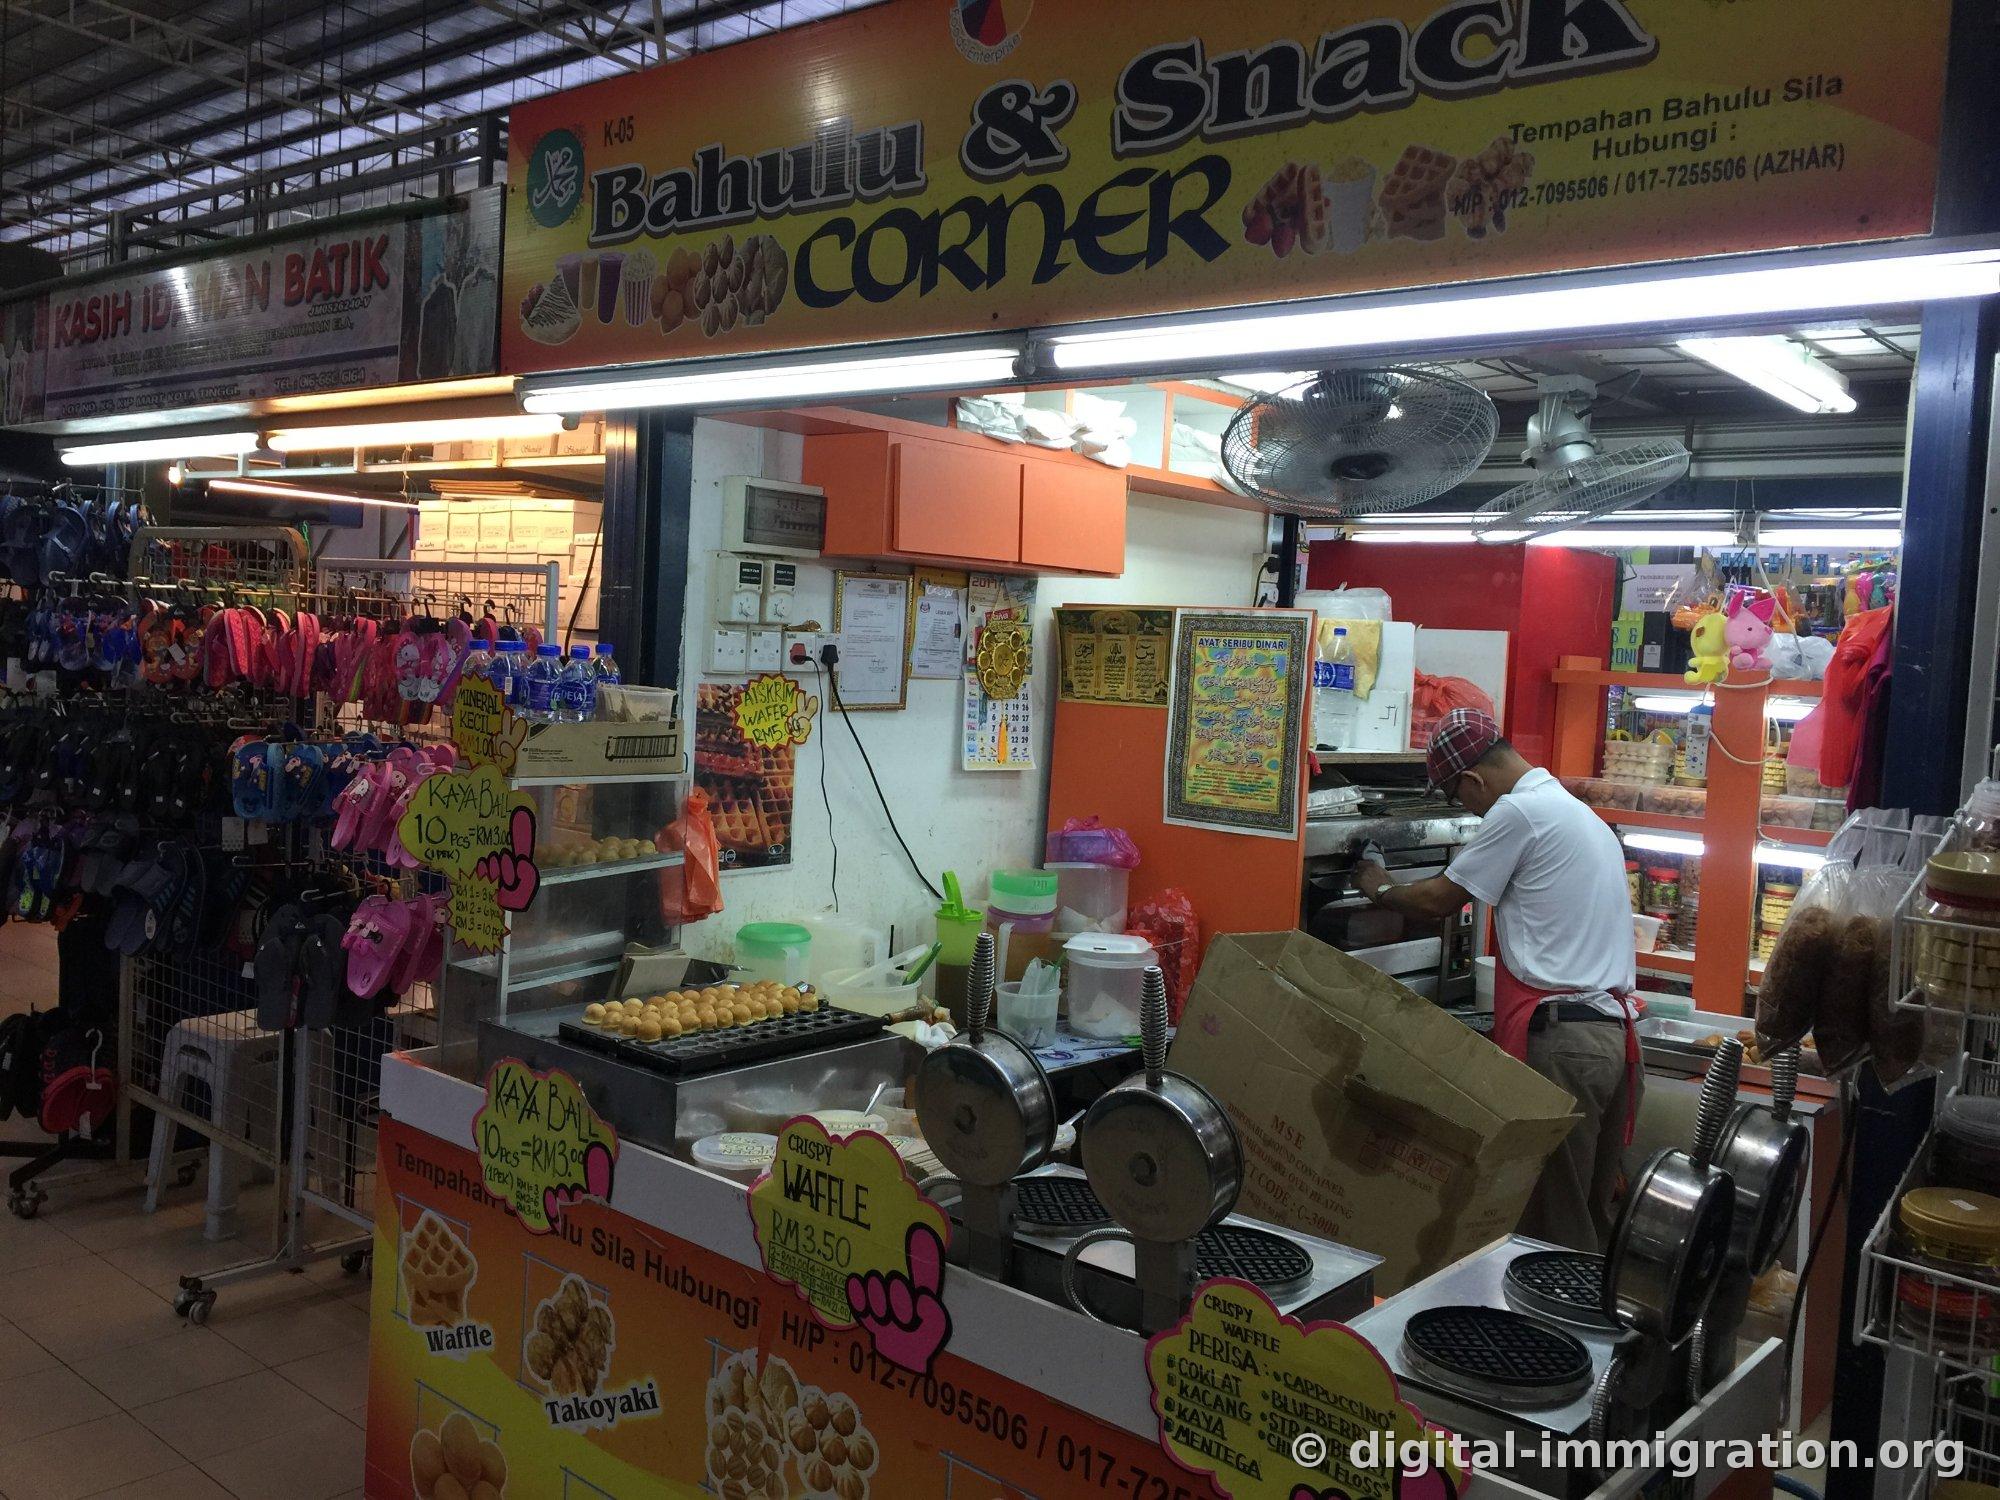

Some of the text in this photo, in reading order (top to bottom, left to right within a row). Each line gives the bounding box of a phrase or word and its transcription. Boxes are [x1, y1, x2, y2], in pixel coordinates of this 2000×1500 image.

[1509, 73, 1844, 144] Tempahan Bahulu Sila
[603, 115, 635, 147] K-05
[1592, 121, 1718, 161] Hubungi
[589, 117, 926, 246] Bahulu
[961, 78, 1078, 178] &
[1500, 174, 1608, 212] 012-7095506
[1625, 154, 1747, 194] 017-7255506
[1753, 141, 1845, 183] (AZHAR)
[54, 287, 132, 348] KASIH
[283, 233, 391, 309] BATIK
[1198, 637, 1285, 650] AYAT SERIBU DINAR
[456, 687, 501, 715] MINERAL
[743, 680, 796, 707] AISKRIM
[459, 709, 494, 735] KECIL
[742, 703, 790, 727] WAFER
[428, 775, 512, 819] KAYA BALL
[414, 813, 448, 845] 10
[450, 831, 471, 849] PCS
[495, 1066, 600, 1145] KAYA BALL
[482, 1119, 501, 1160] 10
[499, 1146, 520, 1168] PCS
[787, 1132, 834, 1167] CRISPY
[782, 1159, 872, 1232] WAFFLE
[772, 1207, 852, 1269] RM3.50
[590, 1226, 636, 1272] Sila
[643, 1248, 761, 1331] Hubungi
[782, 1310, 825, 1353] H/P
[1202, 1292, 1254, 1324] CRISPY
[426, 1324, 493, 1353] Waffle
[1188, 1327, 1260, 1376] PERISA
[1221, 1319, 1281, 1354] WAFFLE
[545, 1382, 660, 1424] Takoyaki
[1172, 1423, 1264, 1481] MENTEGA
